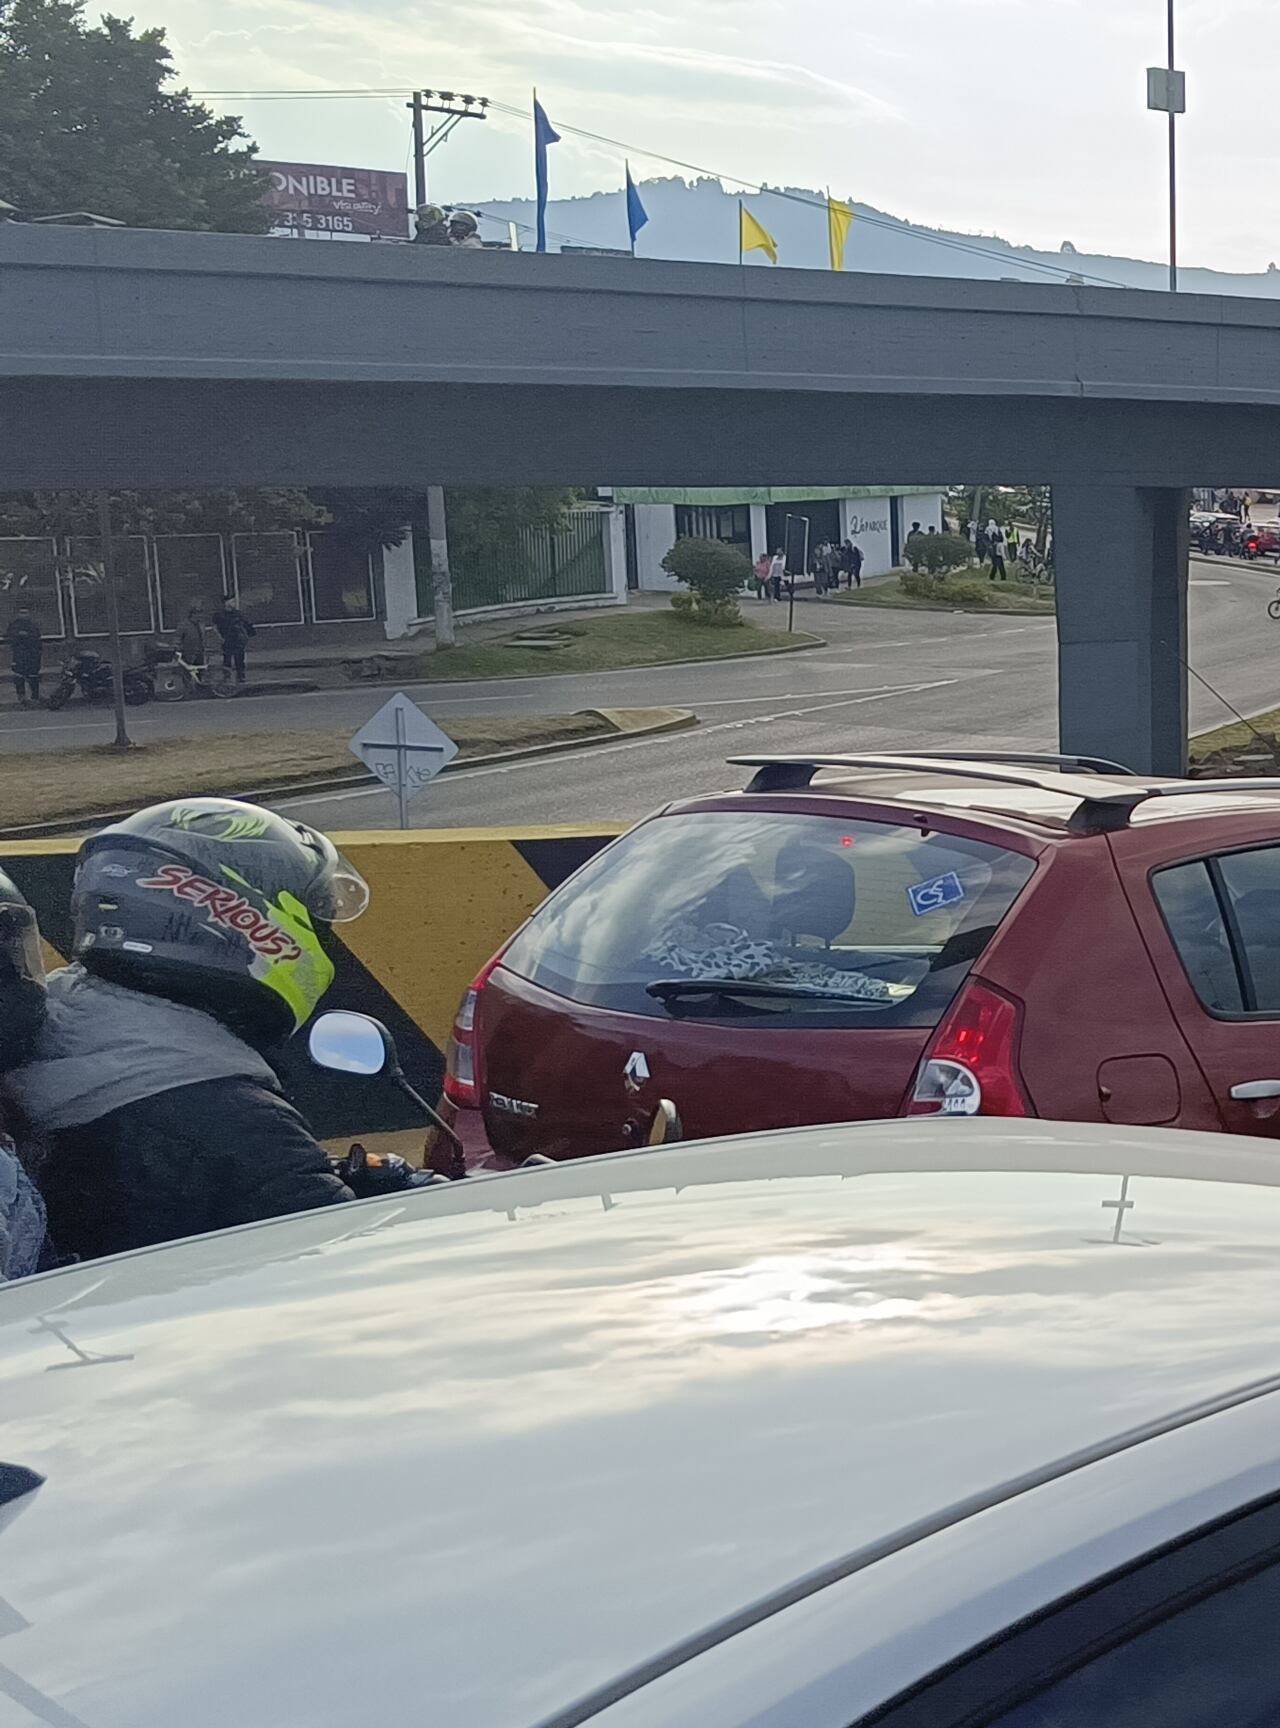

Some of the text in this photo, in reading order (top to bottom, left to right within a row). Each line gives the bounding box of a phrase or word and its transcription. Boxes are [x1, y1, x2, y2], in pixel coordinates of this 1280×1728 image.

[270, 172, 356, 198] ONIBLE
[317, 214, 353, 231] 3165
[136, 864, 302, 965] SERIOUS?
